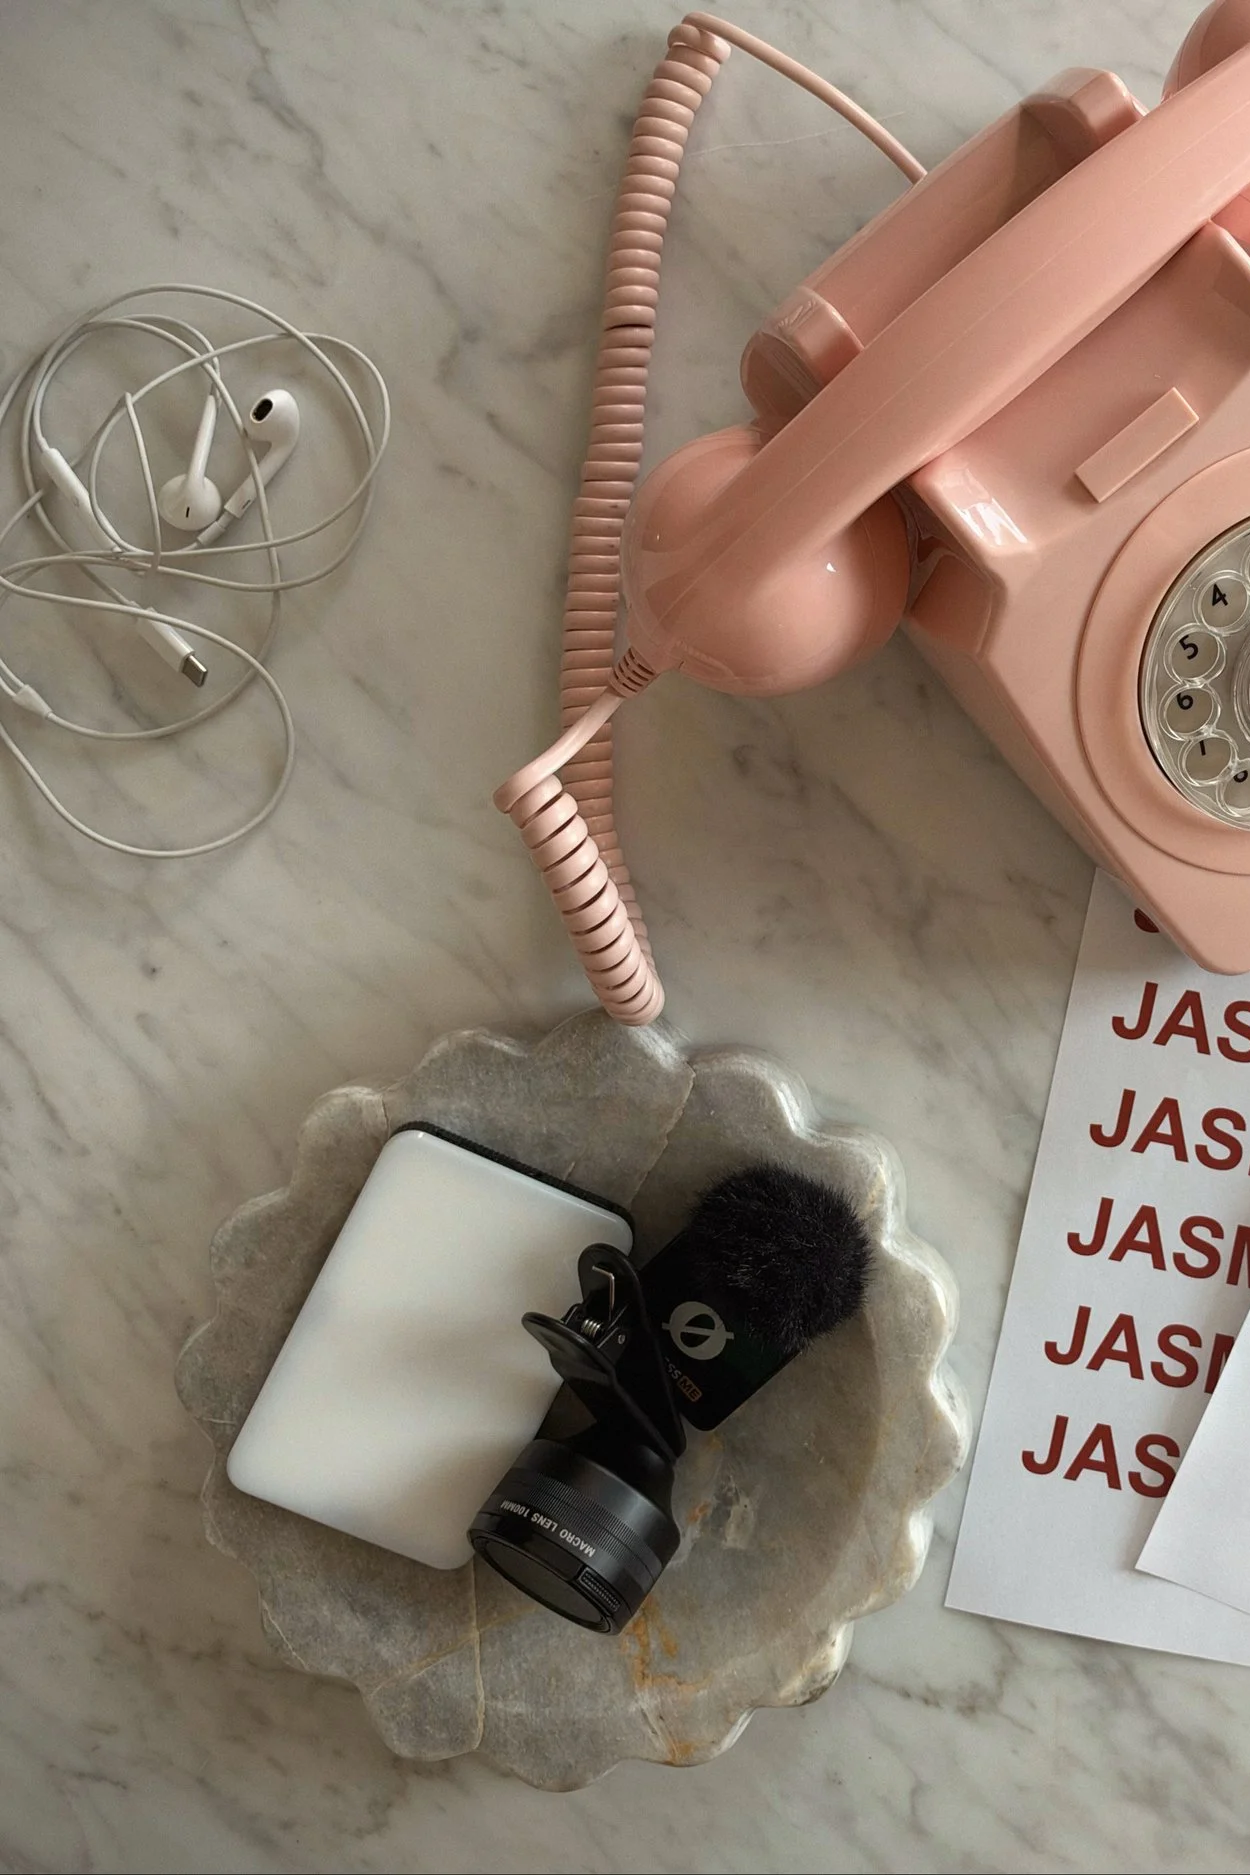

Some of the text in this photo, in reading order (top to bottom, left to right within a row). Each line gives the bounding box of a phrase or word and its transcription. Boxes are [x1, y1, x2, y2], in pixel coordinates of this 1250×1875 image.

[1211, 583, 1229, 607] 4
[1179, 634, 1199, 660] 5
[1176, 692, 1194, 711] 6
[1021, 1415, 1180, 1498] JAS
[501, 1500, 596, 1558] MACRO LENS 100MM
